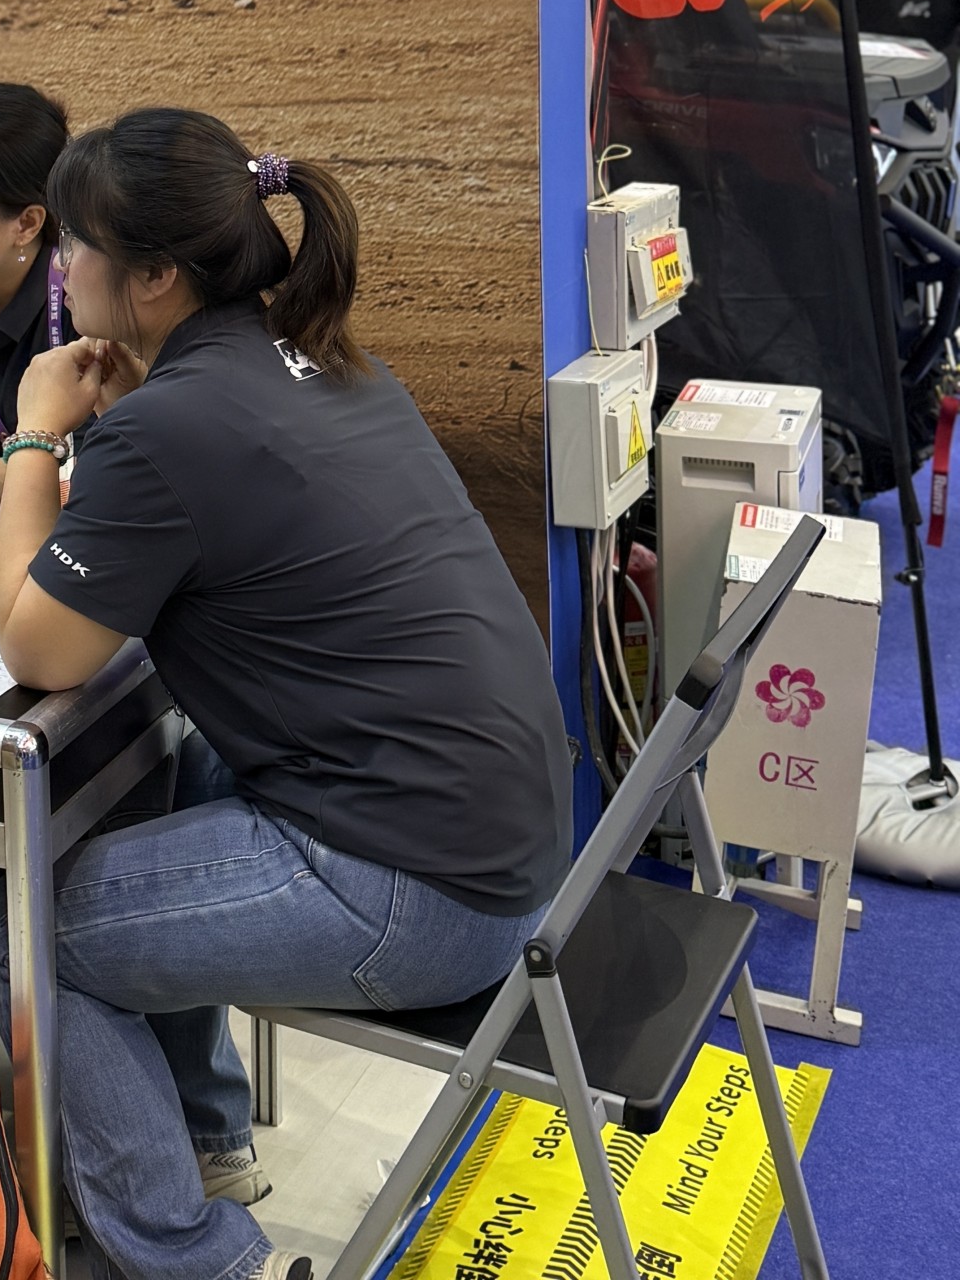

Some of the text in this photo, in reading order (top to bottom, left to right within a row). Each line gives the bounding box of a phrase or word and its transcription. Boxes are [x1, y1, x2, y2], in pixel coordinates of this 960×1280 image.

[50, 542, 91, 578] HDK
[759, 752, 819, 791] C区
[661, 1064, 752, 1216] Mind Your Steps
